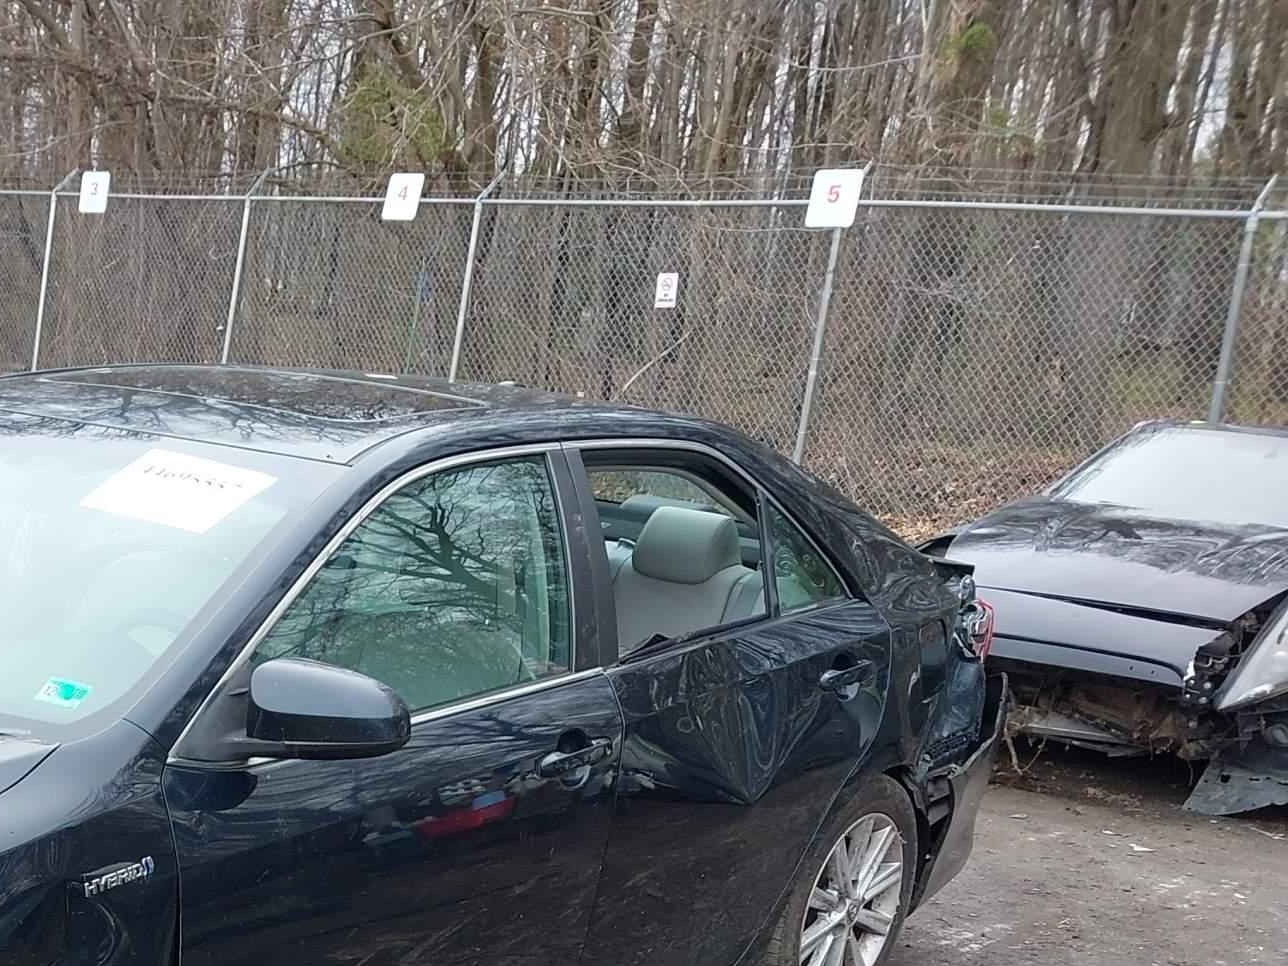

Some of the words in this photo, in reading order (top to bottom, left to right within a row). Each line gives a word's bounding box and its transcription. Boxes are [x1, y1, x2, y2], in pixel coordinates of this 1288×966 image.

[90, 182, 99, 196] 3
[397, 184, 409, 201] 4
[827, 184, 842, 204] 5
[84, 863, 143, 898] HYBRID
